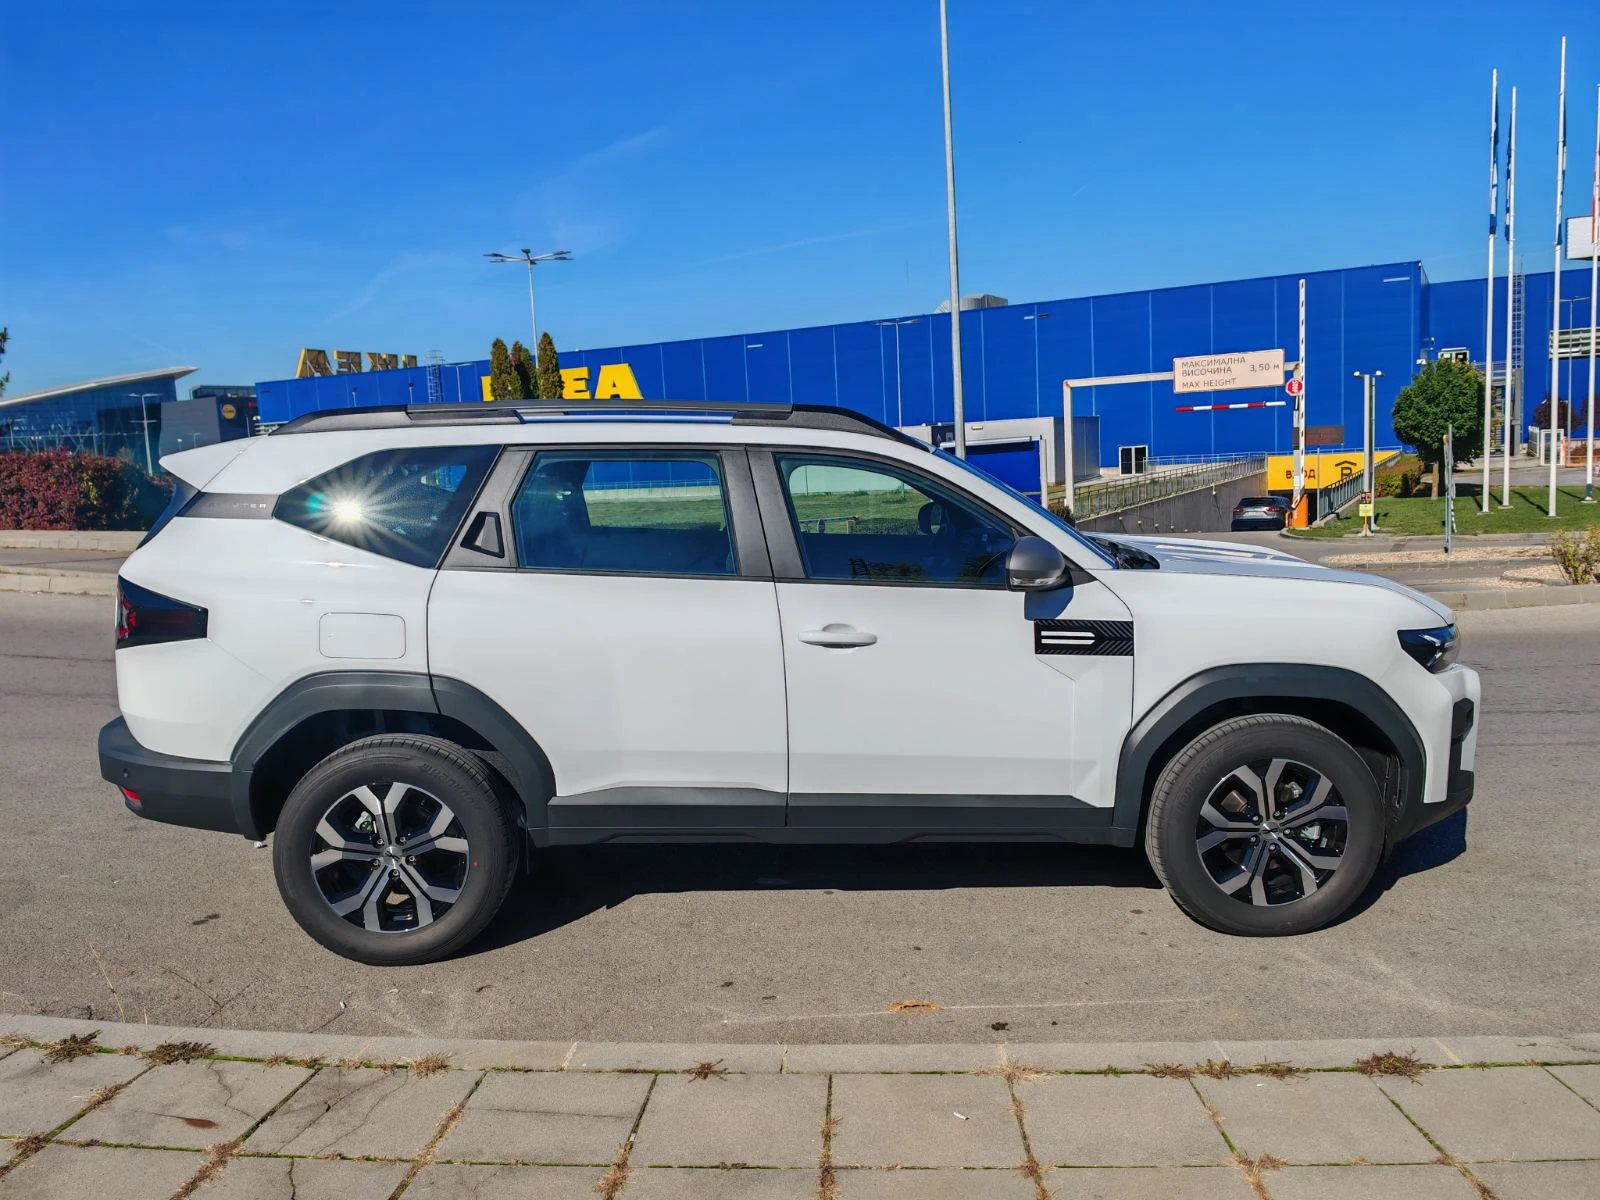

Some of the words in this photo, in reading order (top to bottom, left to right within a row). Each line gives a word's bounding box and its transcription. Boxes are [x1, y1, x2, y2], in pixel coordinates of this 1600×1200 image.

[1181, 356, 1246, 368] МАКСИМАЛНА
[1181, 366, 1232, 377] ВИСОЧИНА
[1203, 377, 1237, 387] HEIGHT
